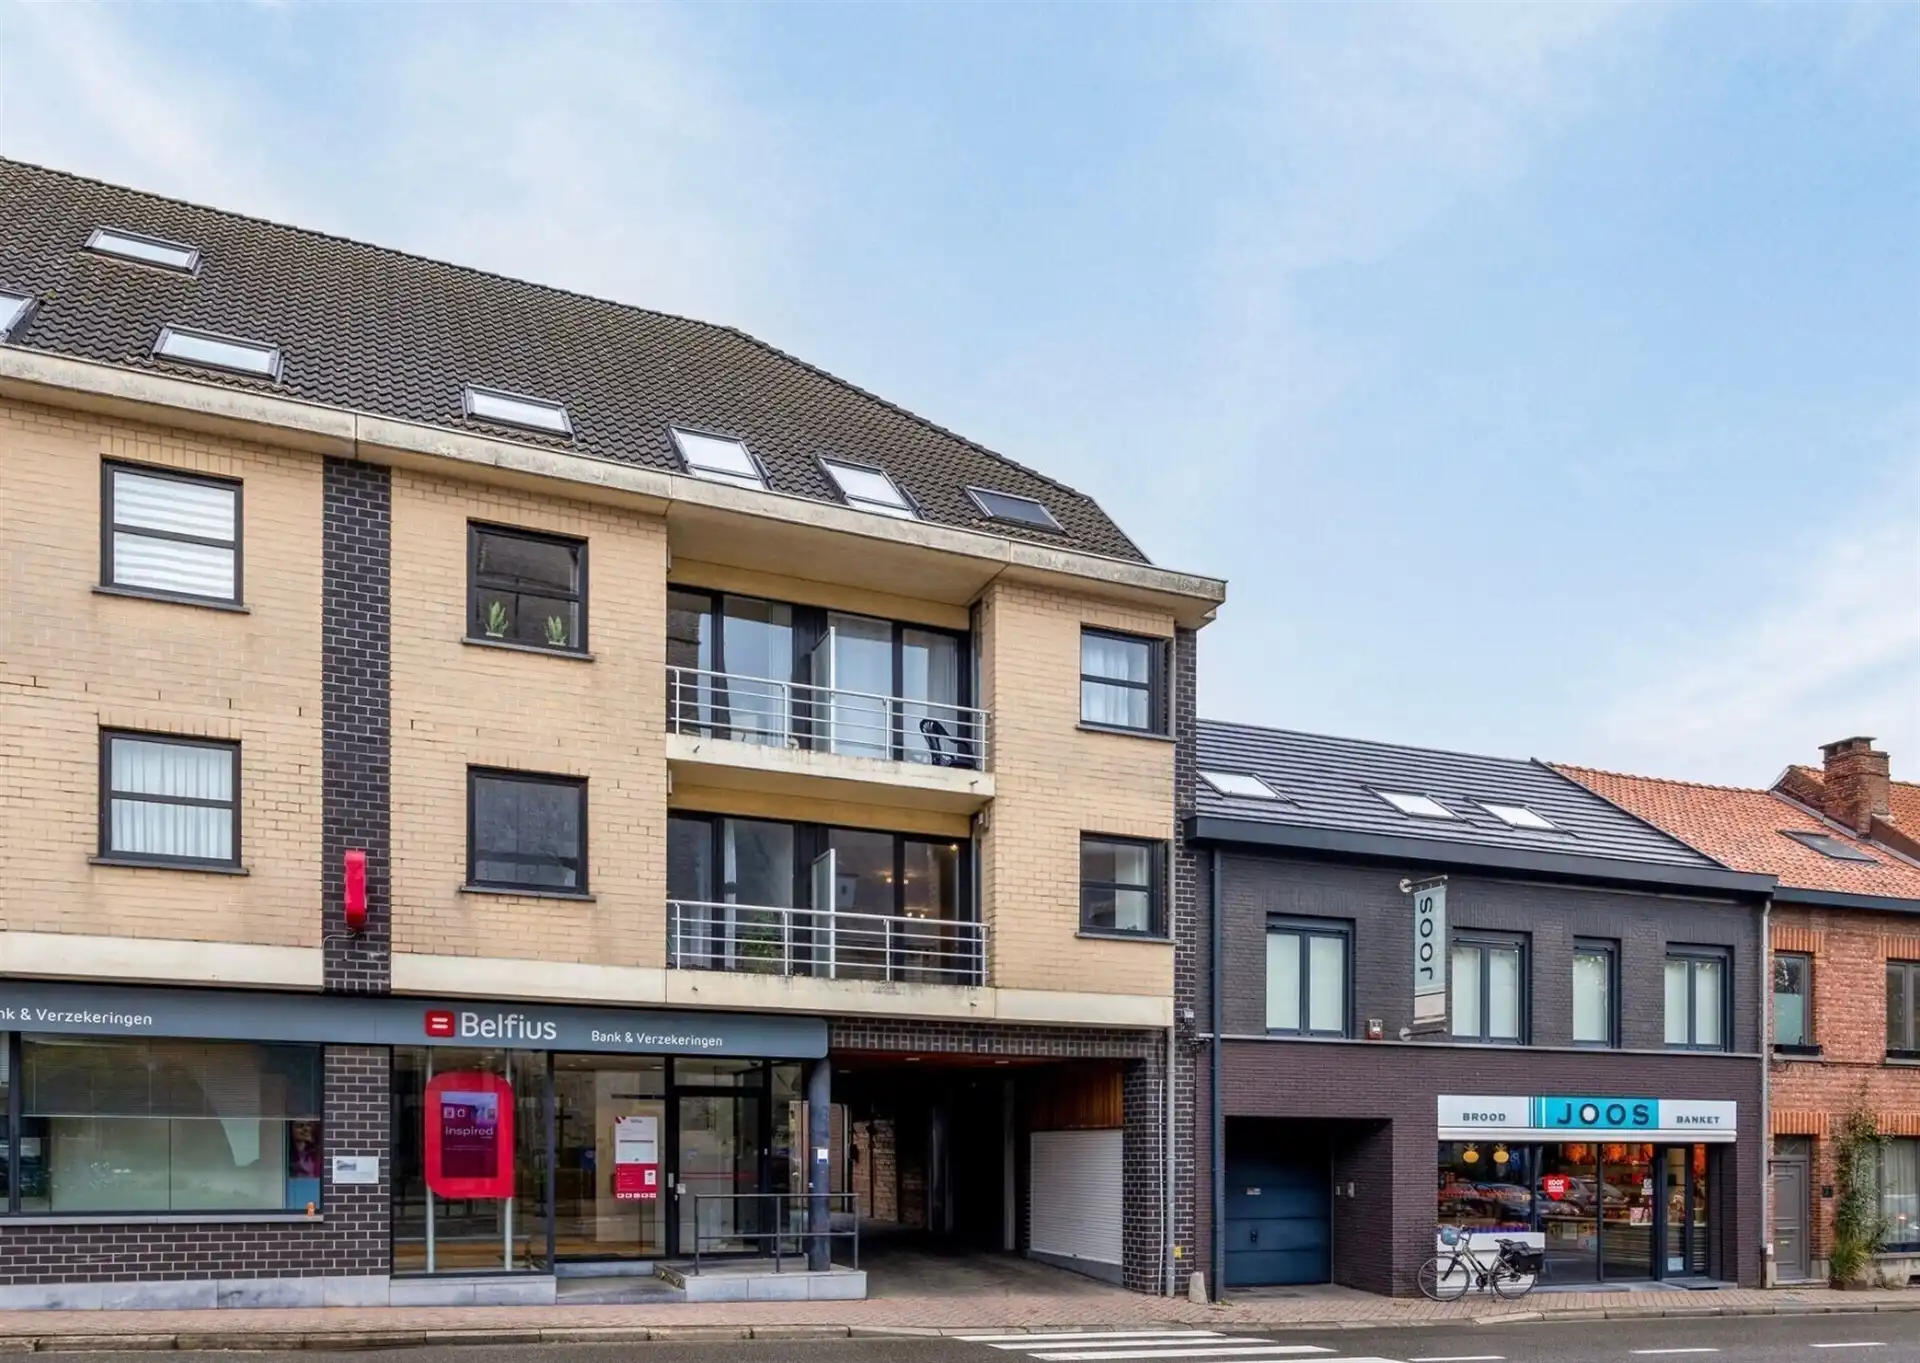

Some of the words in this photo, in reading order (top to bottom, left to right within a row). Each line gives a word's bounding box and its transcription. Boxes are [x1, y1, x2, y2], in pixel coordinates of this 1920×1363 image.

[1420, 896, 1433, 980] JOOS
[20, 1007, 32, 1021] &
[35, 1008, 153, 1027] Verzekeringen
[461, 1011, 557, 1040] Belfius
[591, 1030, 622, 1043] Bank
[625, 1031, 634, 1043] &
[636, 1033, 723, 1049] Verzekeringen
[1462, 1112, 1506, 1122] BROOD
[1556, 1102, 1650, 1126] JOOS
[1676, 1115, 1720, 1125] BANKET
